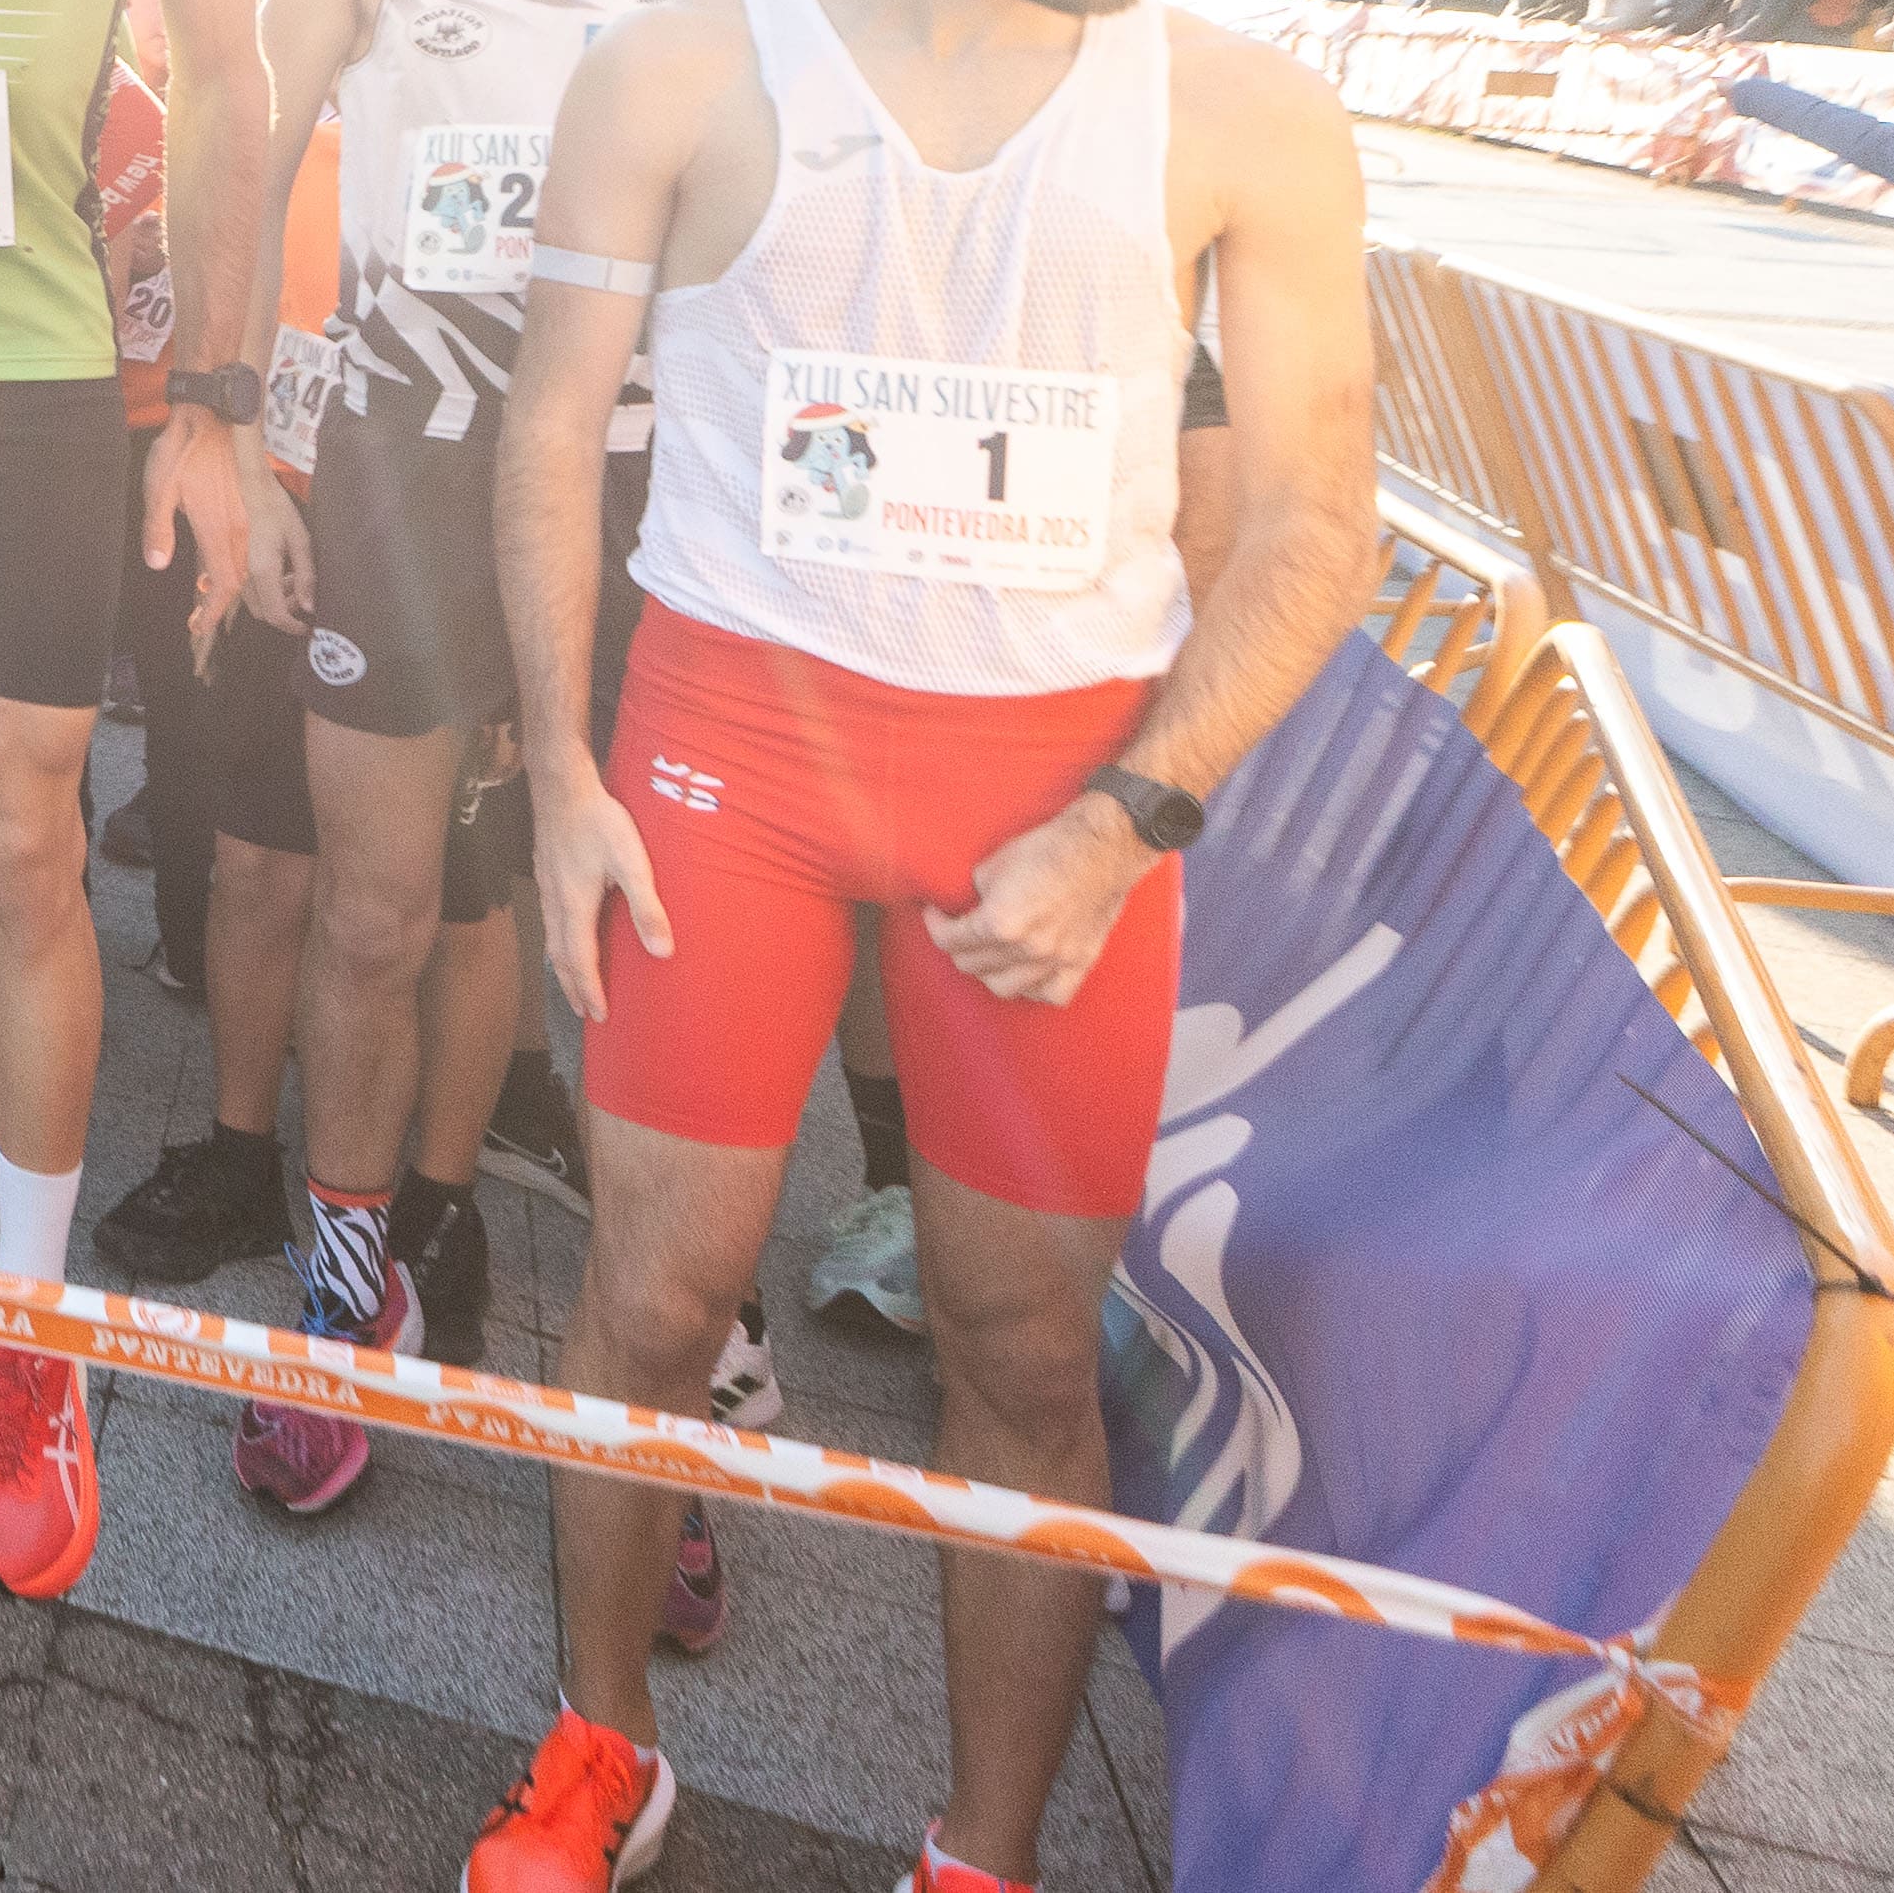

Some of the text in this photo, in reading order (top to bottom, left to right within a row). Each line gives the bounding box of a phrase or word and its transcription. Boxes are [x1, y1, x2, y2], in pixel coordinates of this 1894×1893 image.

[424, 135, 461, 164] XLII
[473, 134, 518, 166] SAN
[784, 363, 1099, 430] XLII SAN SILVESTRE
[978, 432, 1008, 502] 1
[883, 502, 1091, 548] PONTEVEDRA 2025
